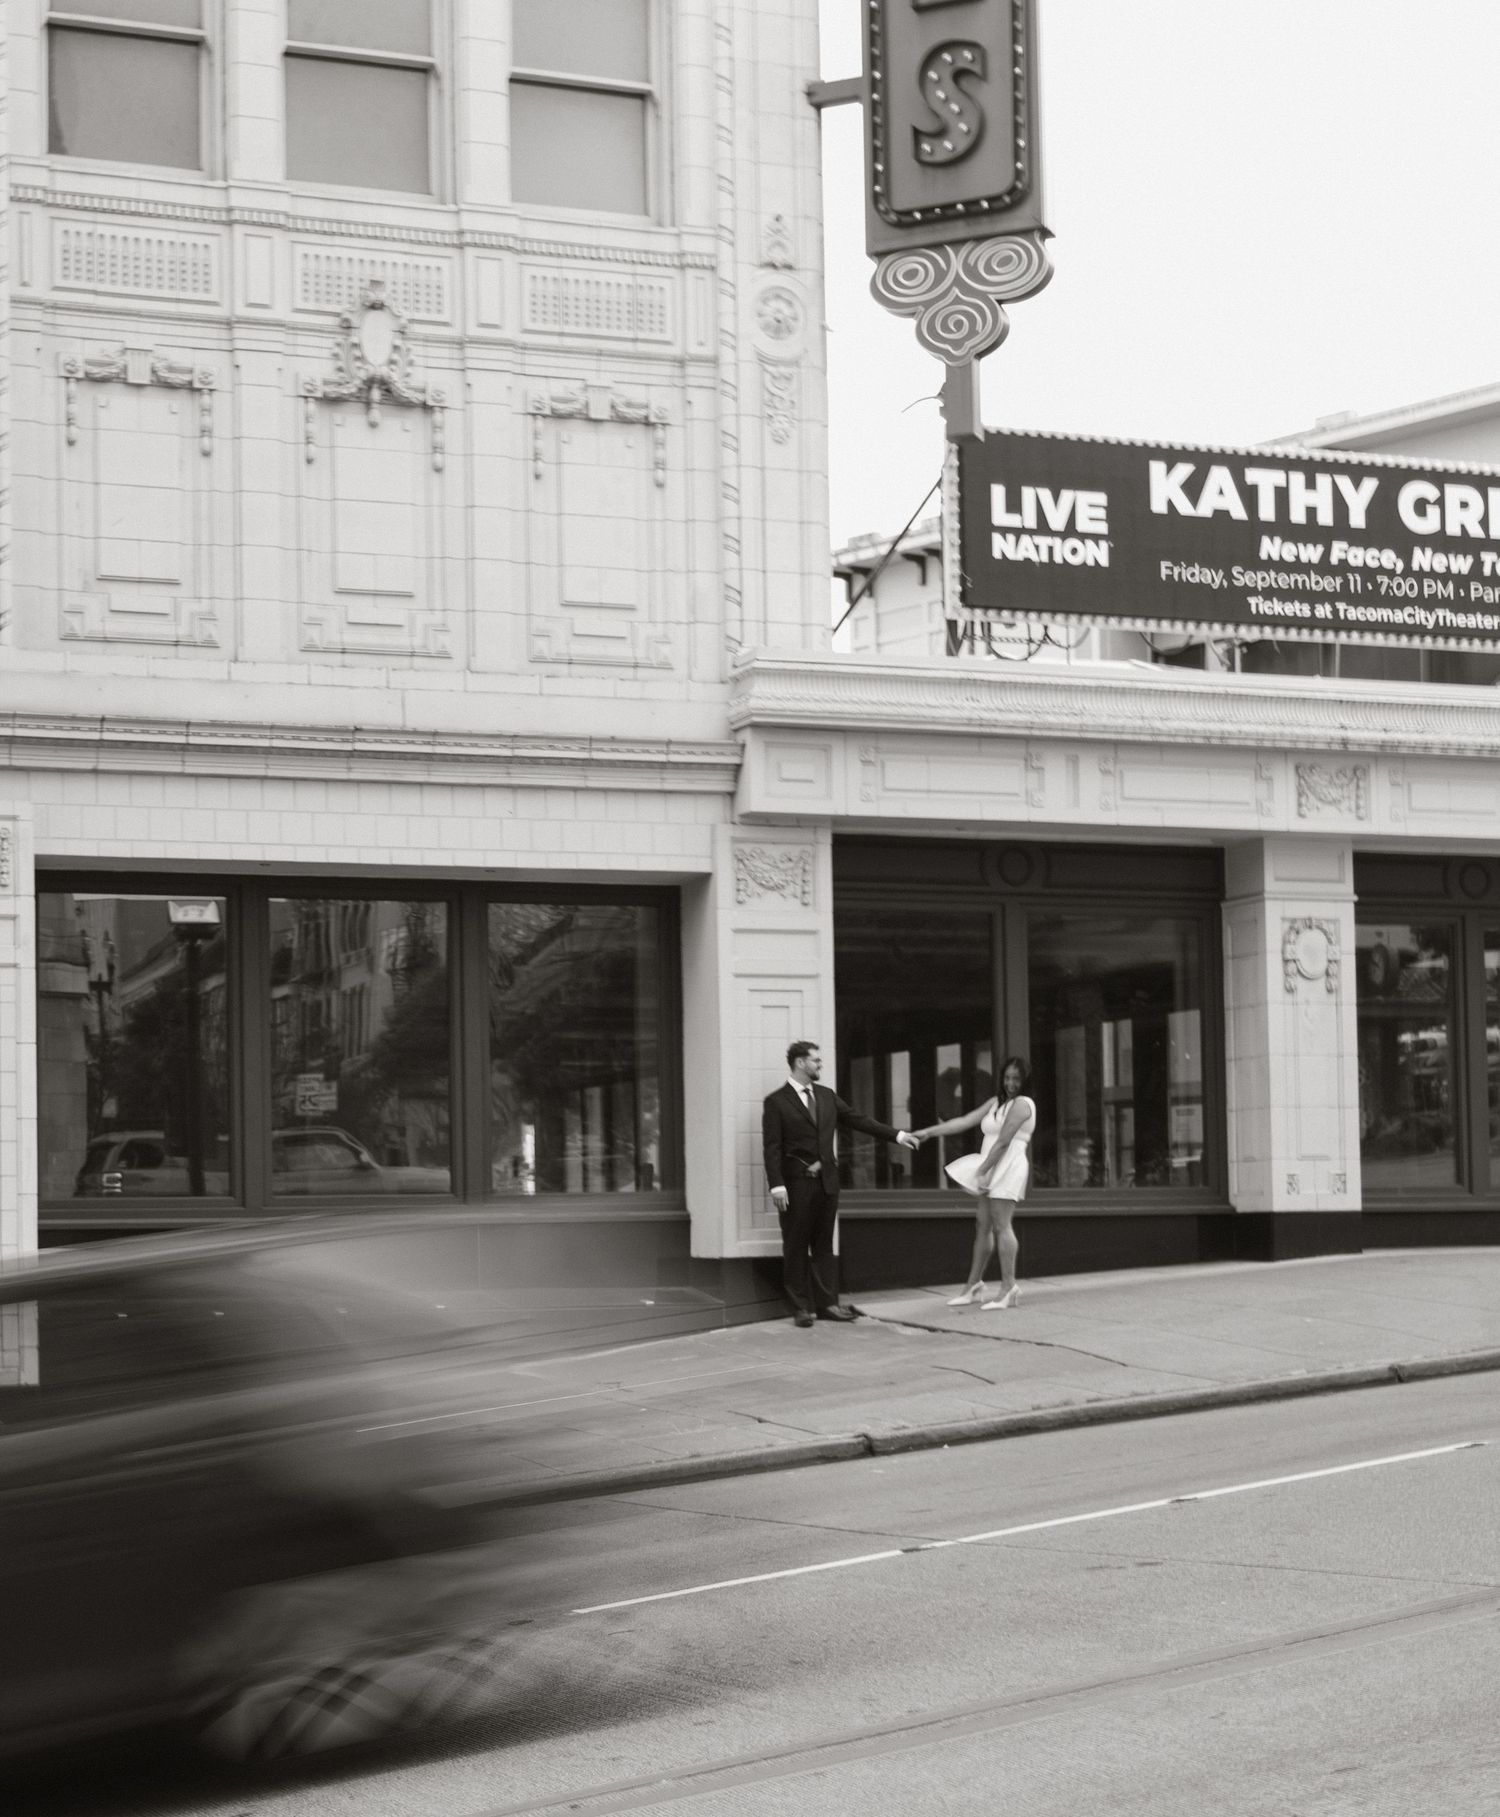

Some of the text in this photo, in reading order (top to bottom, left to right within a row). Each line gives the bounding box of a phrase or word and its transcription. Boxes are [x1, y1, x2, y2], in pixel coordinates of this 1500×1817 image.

[911, 0, 988, 167] S
[990, 483, 1109, 535] LIVE
[1149, 460, 1379, 529] KATHY
[991, 532, 1110, 568] NATION
[1259, 534, 1325, 564] New
[1329, 540, 1404, 575] Face,
[1411, 546, 1474, 575] New
[1160, 560, 1228, 590] Friday,
[1231, 565, 1344, 594] September
[1346, 573, 1362, 594] 11
[1376, 574, 1419, 599] 7:00
[1423, 578, 1454, 601] PM
[1247, 595, 1500, 630] Tickets at TacomaCityTheater
